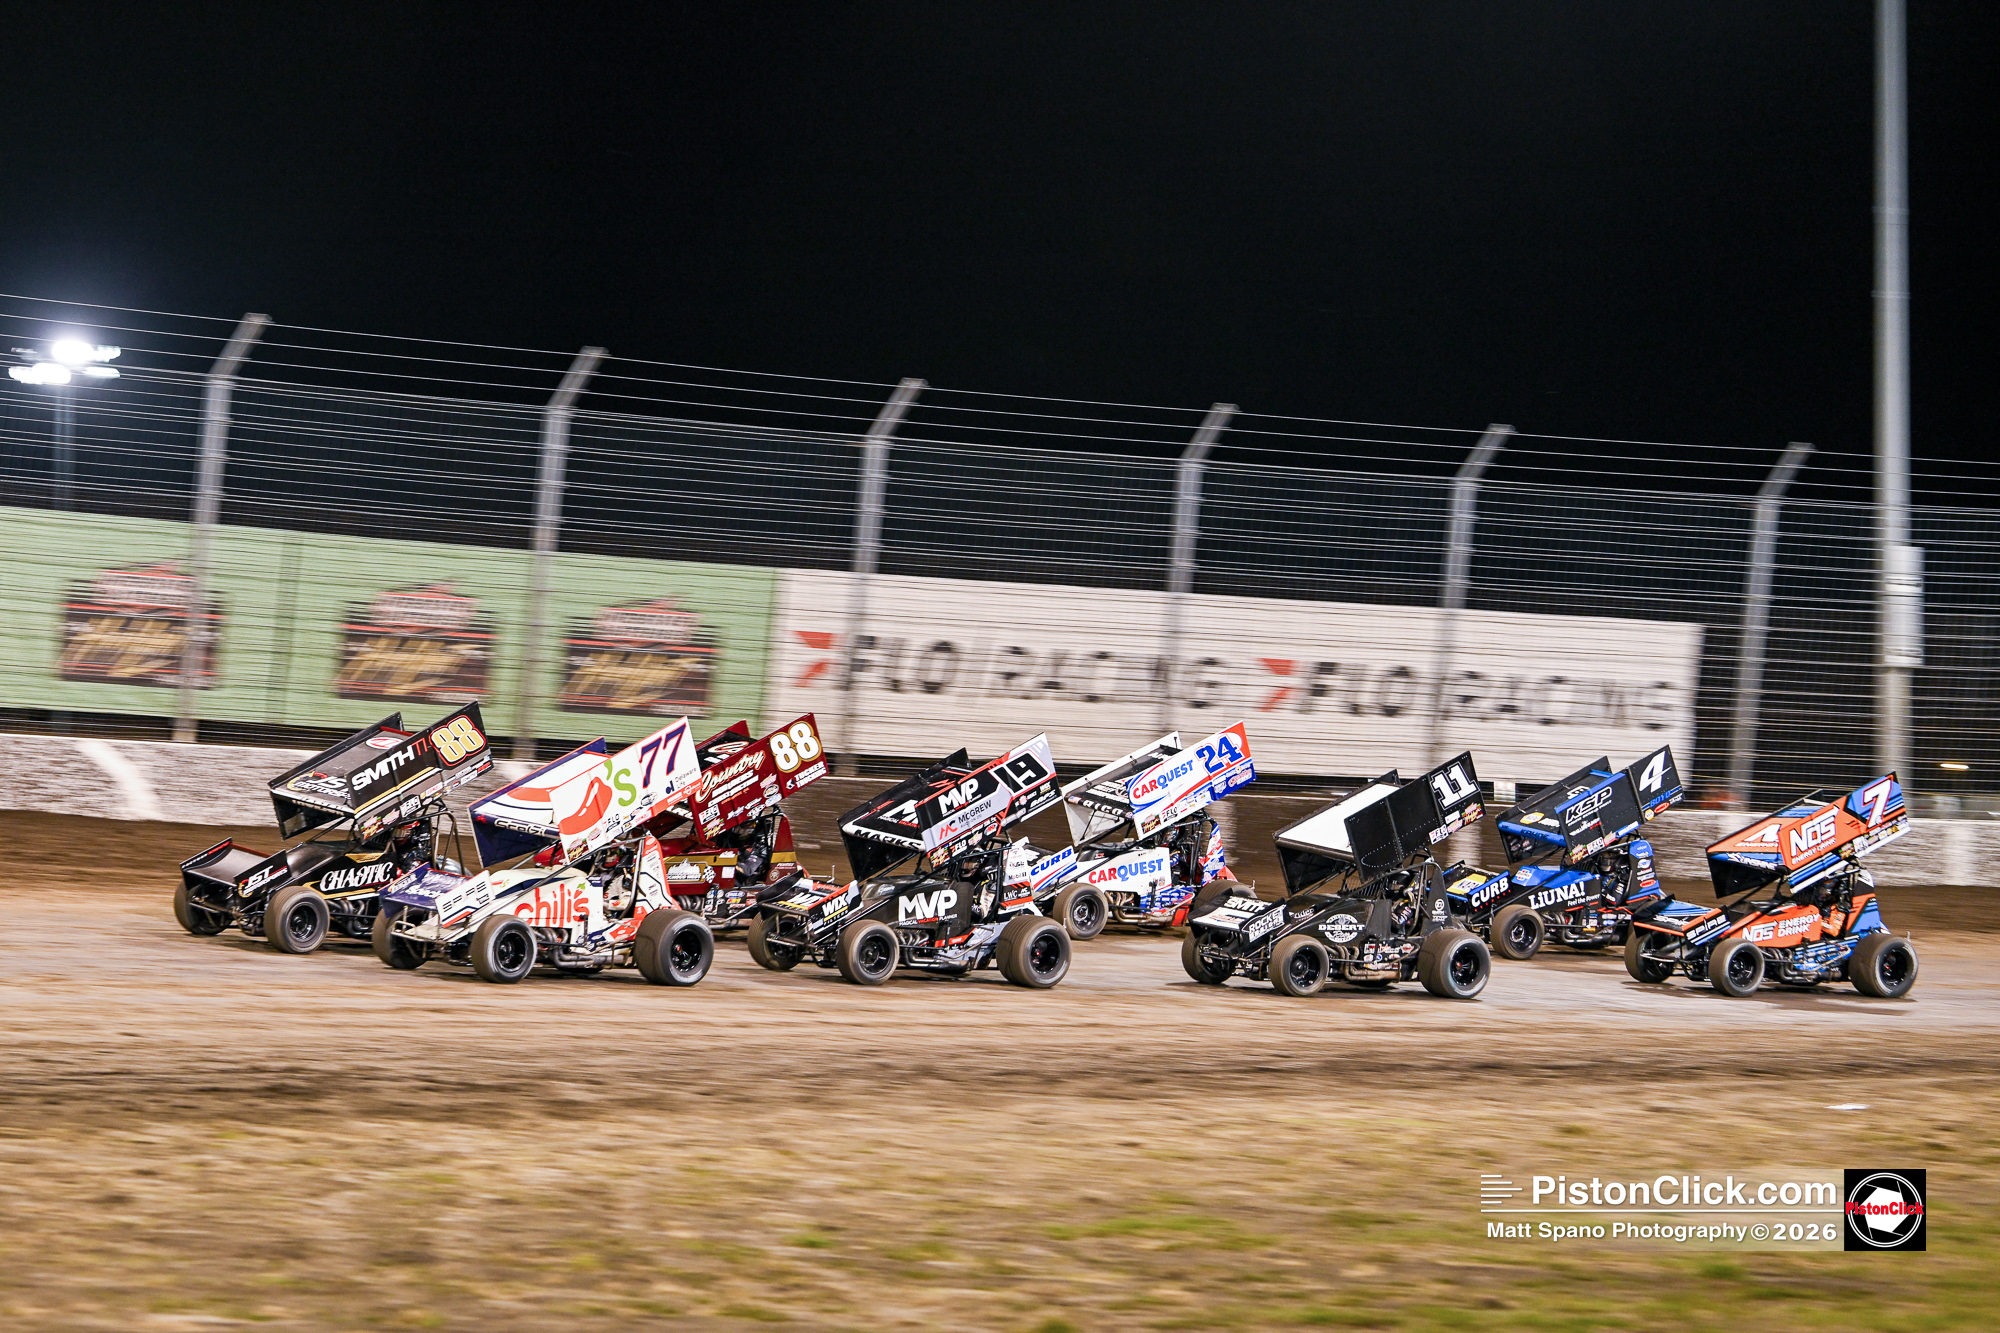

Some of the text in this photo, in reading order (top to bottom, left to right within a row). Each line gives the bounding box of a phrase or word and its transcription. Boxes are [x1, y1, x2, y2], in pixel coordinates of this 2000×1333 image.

[431, 716, 485, 765] 88
[639, 722, 687, 789] 77
[770, 721, 820, 772] 88
[1196, 735, 1244, 774] 24
[993, 751, 1050, 795] 19
[1132, 759, 1194, 800] CARQUEST
[1431, 762, 1478, 809] 11
[1639, 750, 1672, 793] 4
[937, 778, 979, 816] MVP
[1565, 786, 1613, 824] KSP
[1863, 778, 1893, 830] 7
[1789, 805, 1840, 858] NOS
[319, 861, 394, 892] CHAOTIC
[1030, 848, 1073, 876] CURB
[1088, 858, 1164, 884] CARQUEST
[821, 892, 849, 917] WIX
[898, 889, 958, 921] MVP
[1471, 876, 1509, 908] CURB
[1528, 881, 1586, 910] LiUNA!
[1686, 914, 1727, 940] SPIRE
[1742, 920, 1779, 942] NOS
[1777, 924, 1810, 938] DRINK
[1778, 913, 1820, 929] ENERGY
